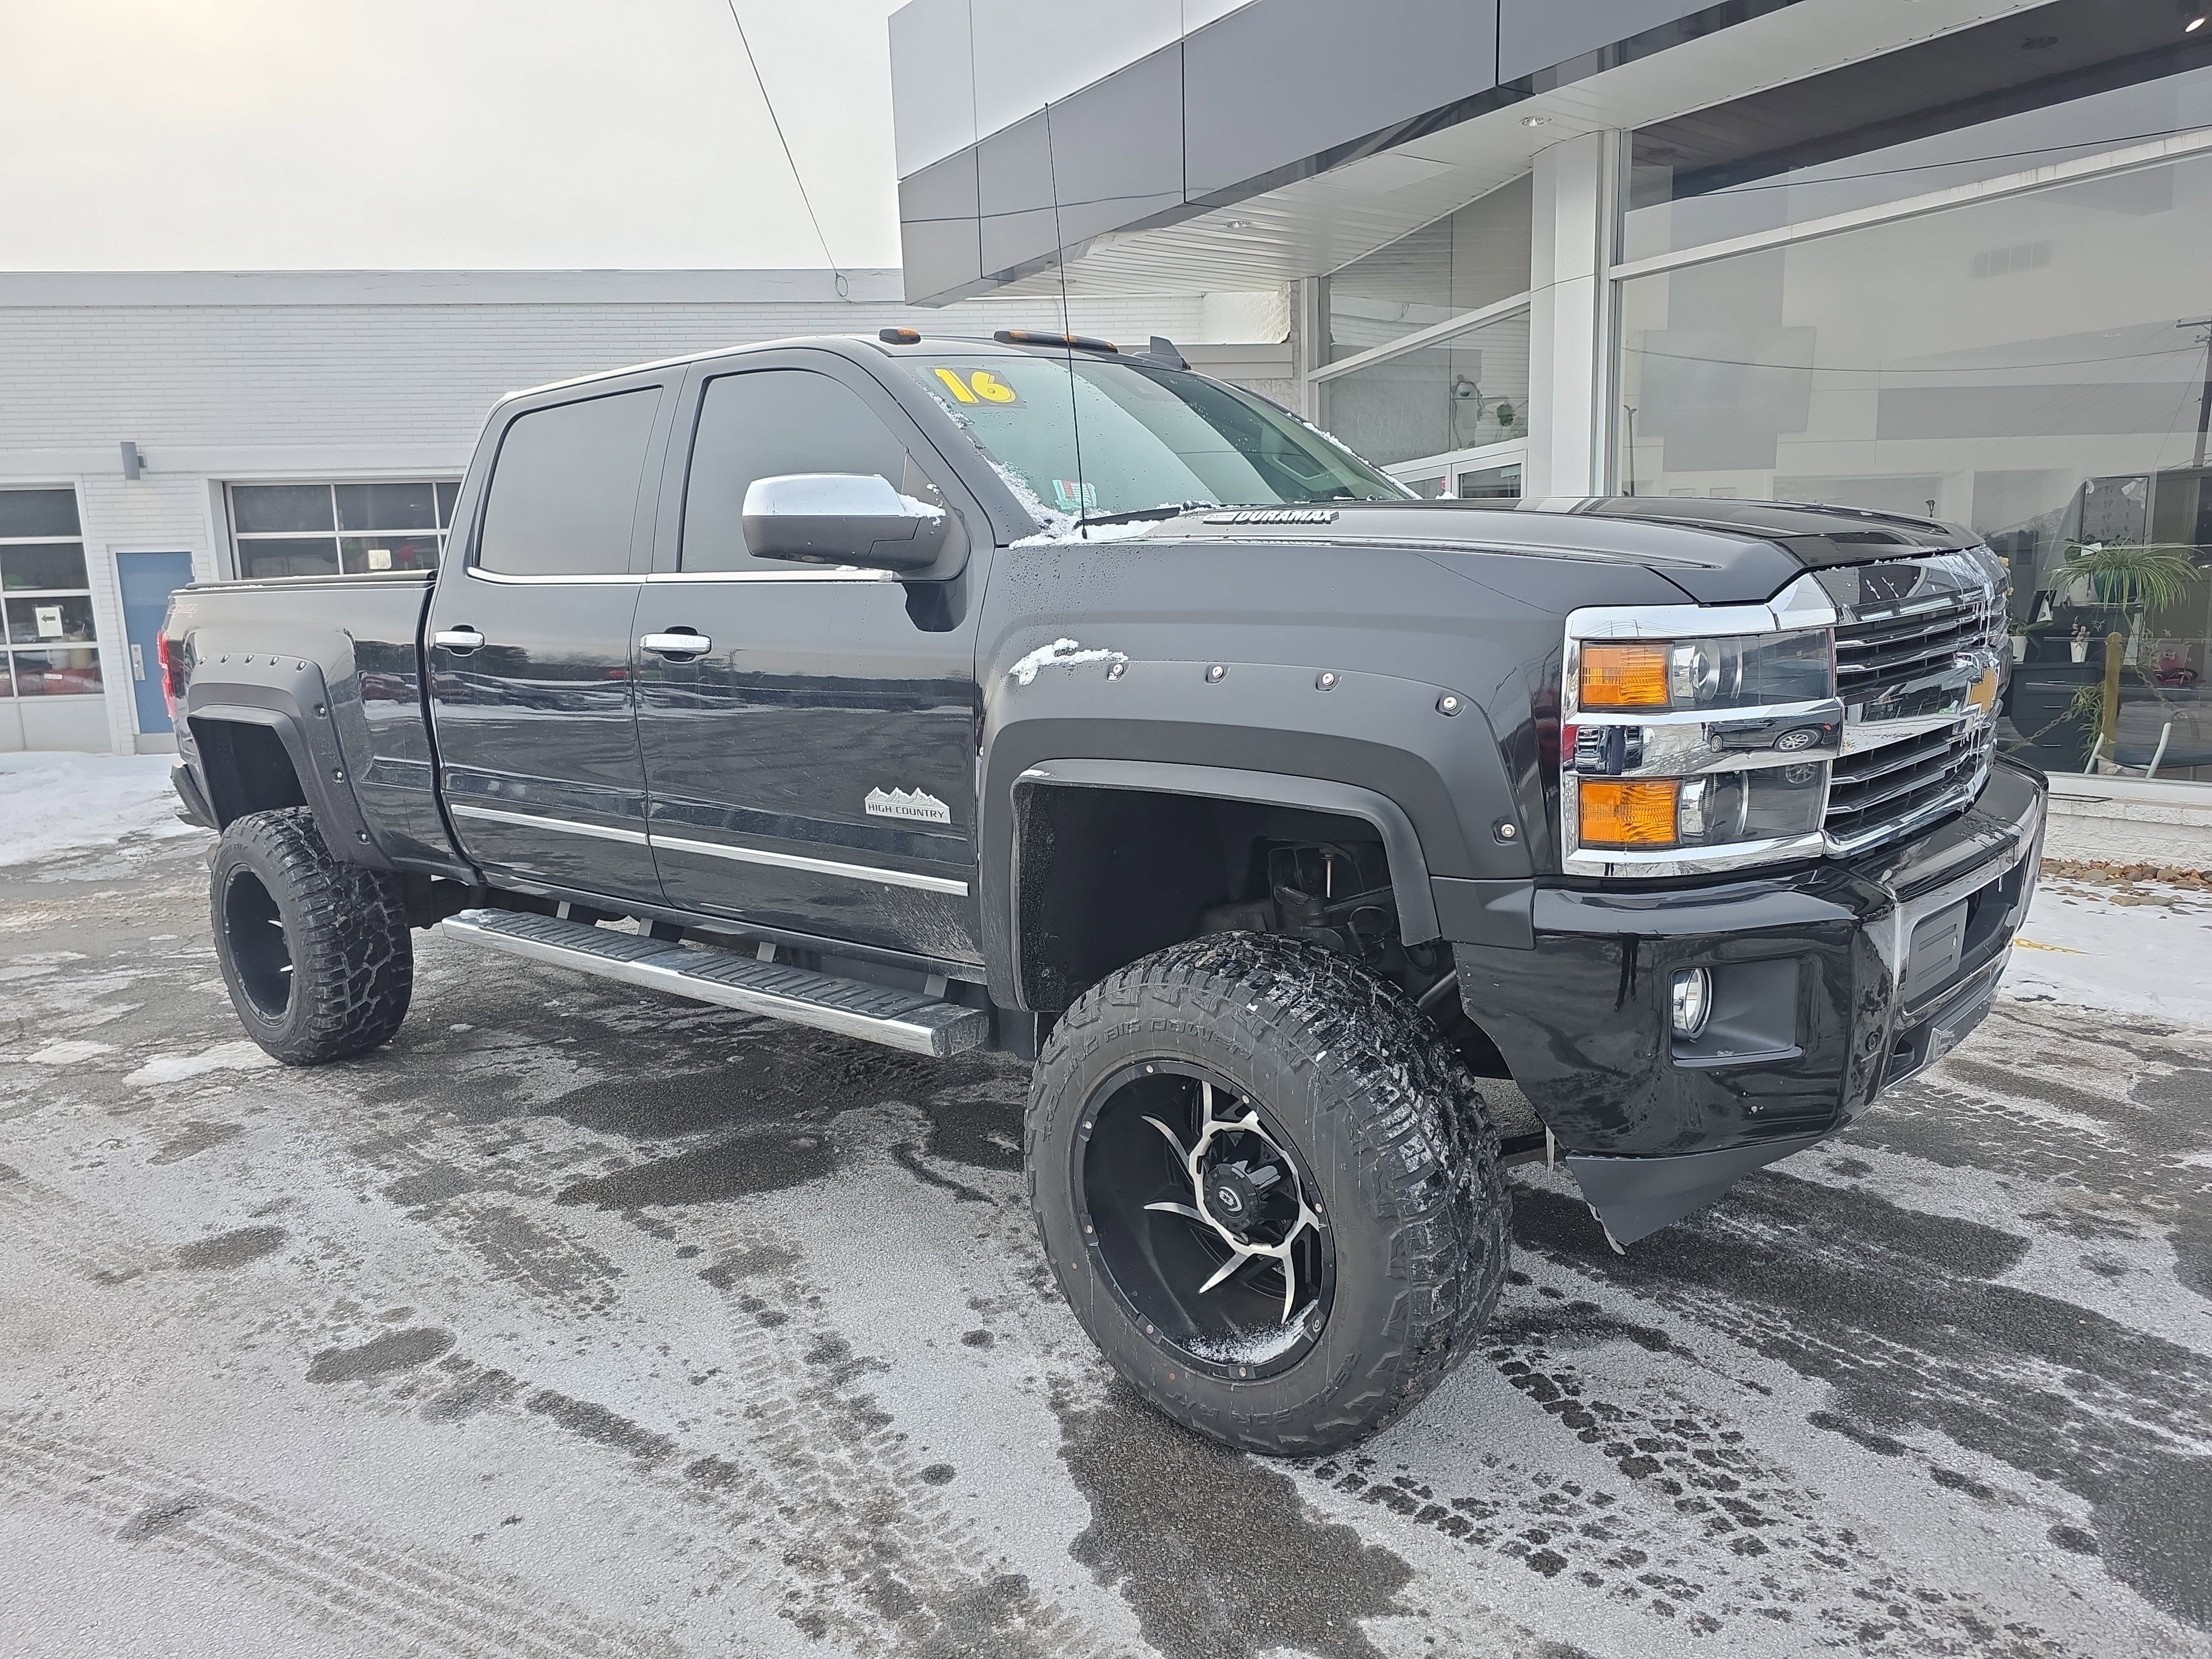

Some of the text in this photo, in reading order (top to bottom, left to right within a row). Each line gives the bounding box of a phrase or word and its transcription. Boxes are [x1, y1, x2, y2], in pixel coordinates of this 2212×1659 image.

[934, 369, 1016, 403] 16
[1234, 511, 1335, 523] DURAMAX
[868, 803, 946, 819] HIGH COUNTRY
[1103, 1018, 1141, 1043] BIG
[1149, 1018, 1253, 1060] POWER
